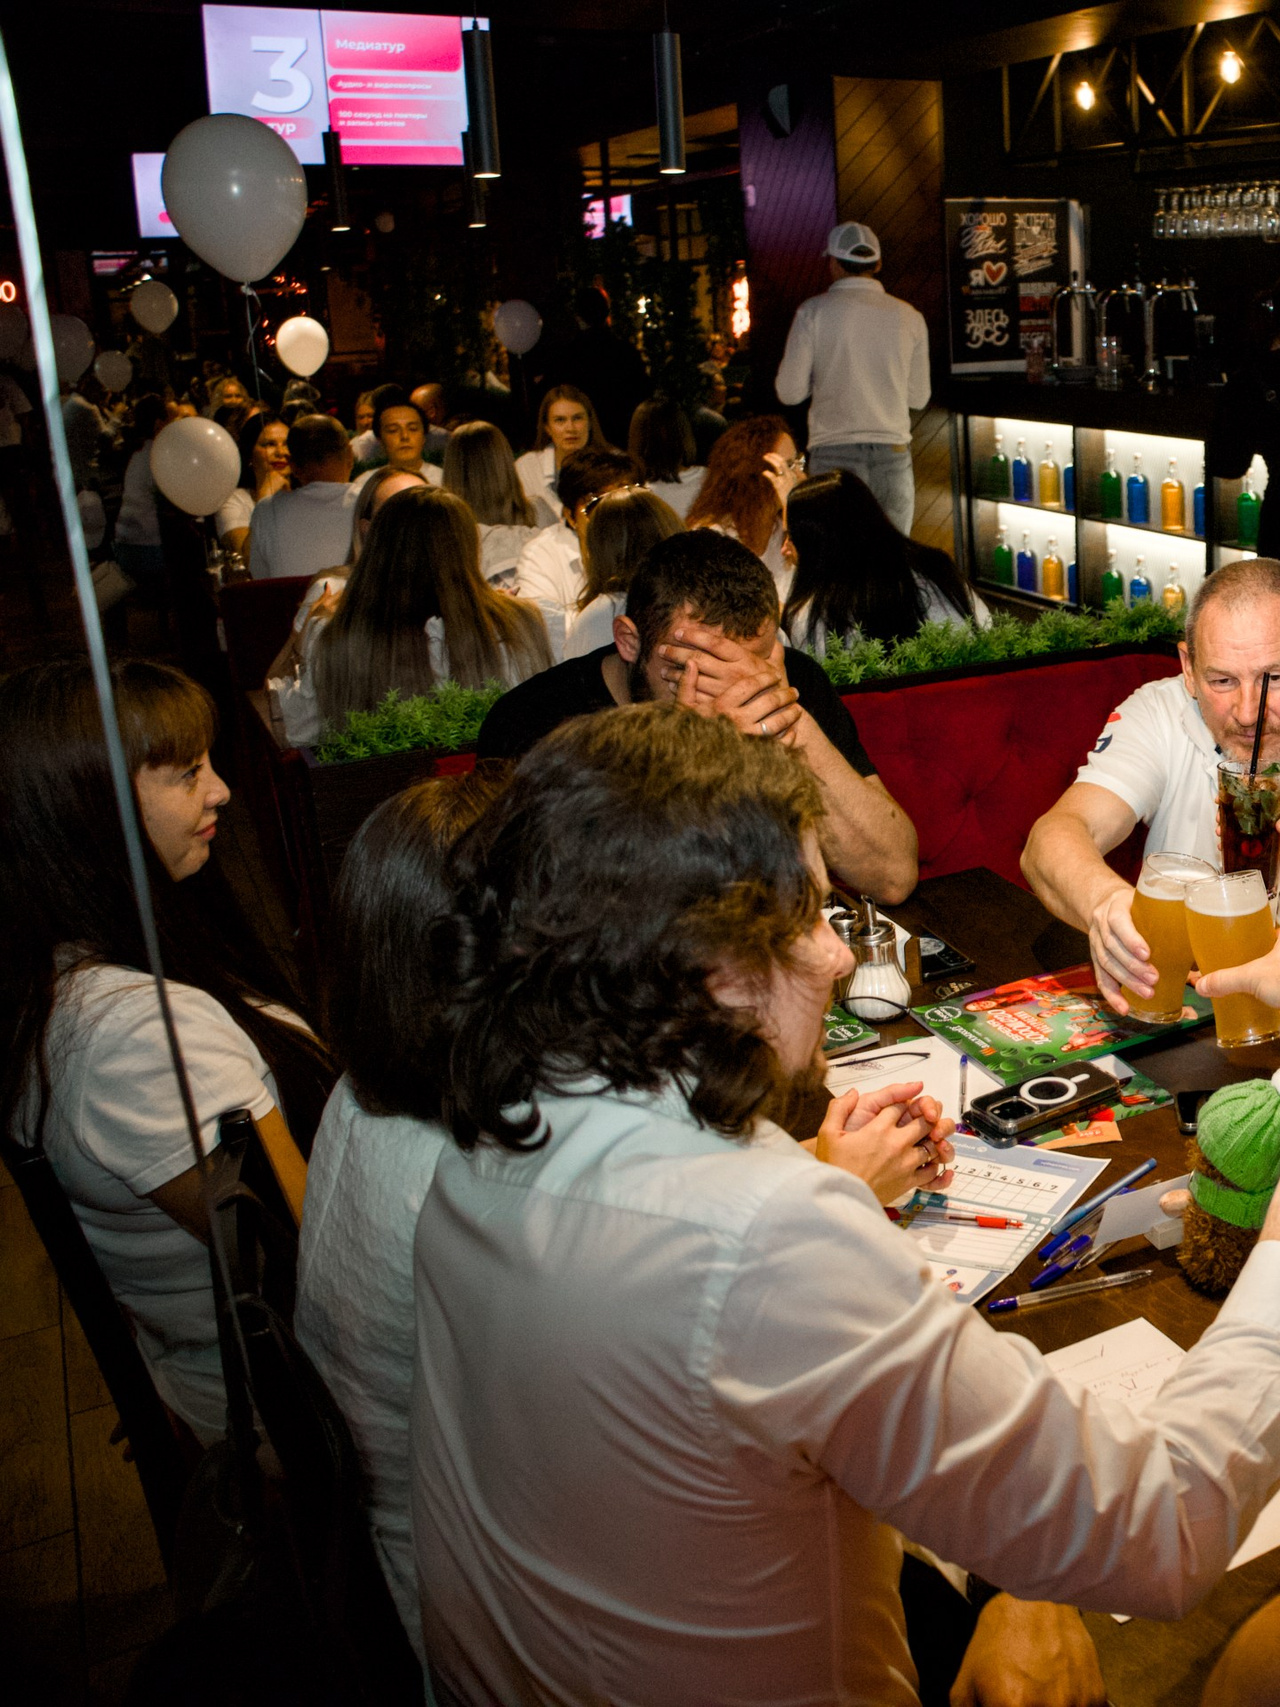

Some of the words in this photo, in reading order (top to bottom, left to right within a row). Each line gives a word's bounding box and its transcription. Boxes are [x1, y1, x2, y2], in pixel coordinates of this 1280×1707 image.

[335, 38, 406, 53] Медиатур
[250, 35, 314, 114] 3
[960, 212, 1007, 226] ХОРОШО
[969, 269, 985, 286] Я
[965, 308, 1010, 326] ЗДЕСЬ
